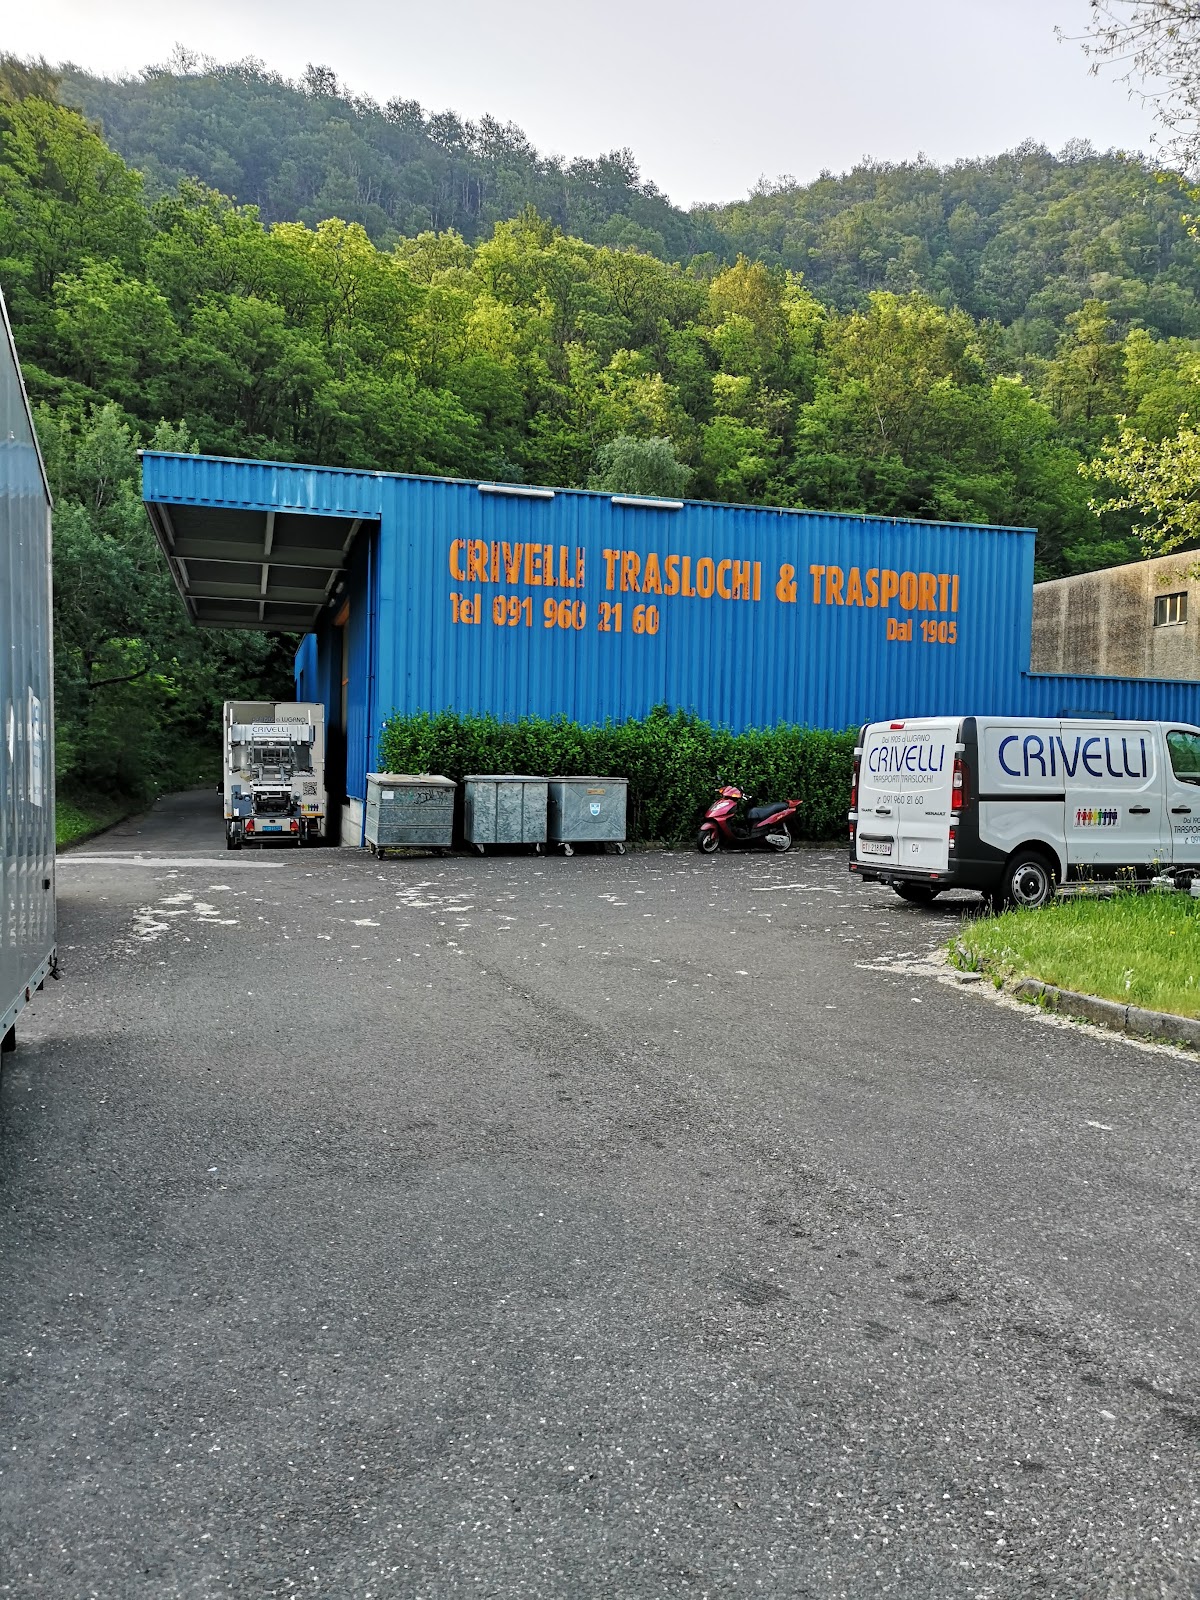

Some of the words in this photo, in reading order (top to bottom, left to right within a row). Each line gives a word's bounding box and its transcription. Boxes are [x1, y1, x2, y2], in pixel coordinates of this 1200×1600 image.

[449, 538, 586, 588] CRIVELLI
[602, 549, 762, 601] TRASLOCHI
[775, 563, 798, 603] &
[809, 564, 960, 613] TRASPORTI
[450, 592, 481, 624] Tel
[492, 595, 533, 627] 091
[543, 598, 587, 630] 960
[597, 602, 623, 633] 21
[632, 604, 660, 635] 60
[886, 618, 912, 642] Dal
[920, 620, 958, 644] 1905
[906, 734, 931, 742] LUGANO
[868, 744, 945, 772] CRIVELLI
[998, 735, 1148, 778] CRIVELLI
[873, 775, 900, 784] TRASPORTI
[901, 774, 934, 784] TRASLOCHI
[883, 796, 893, 804] 091
[894, 796, 905, 805] 960
[914, 796, 924, 805] 60
[911, 844, 919, 853] CH
